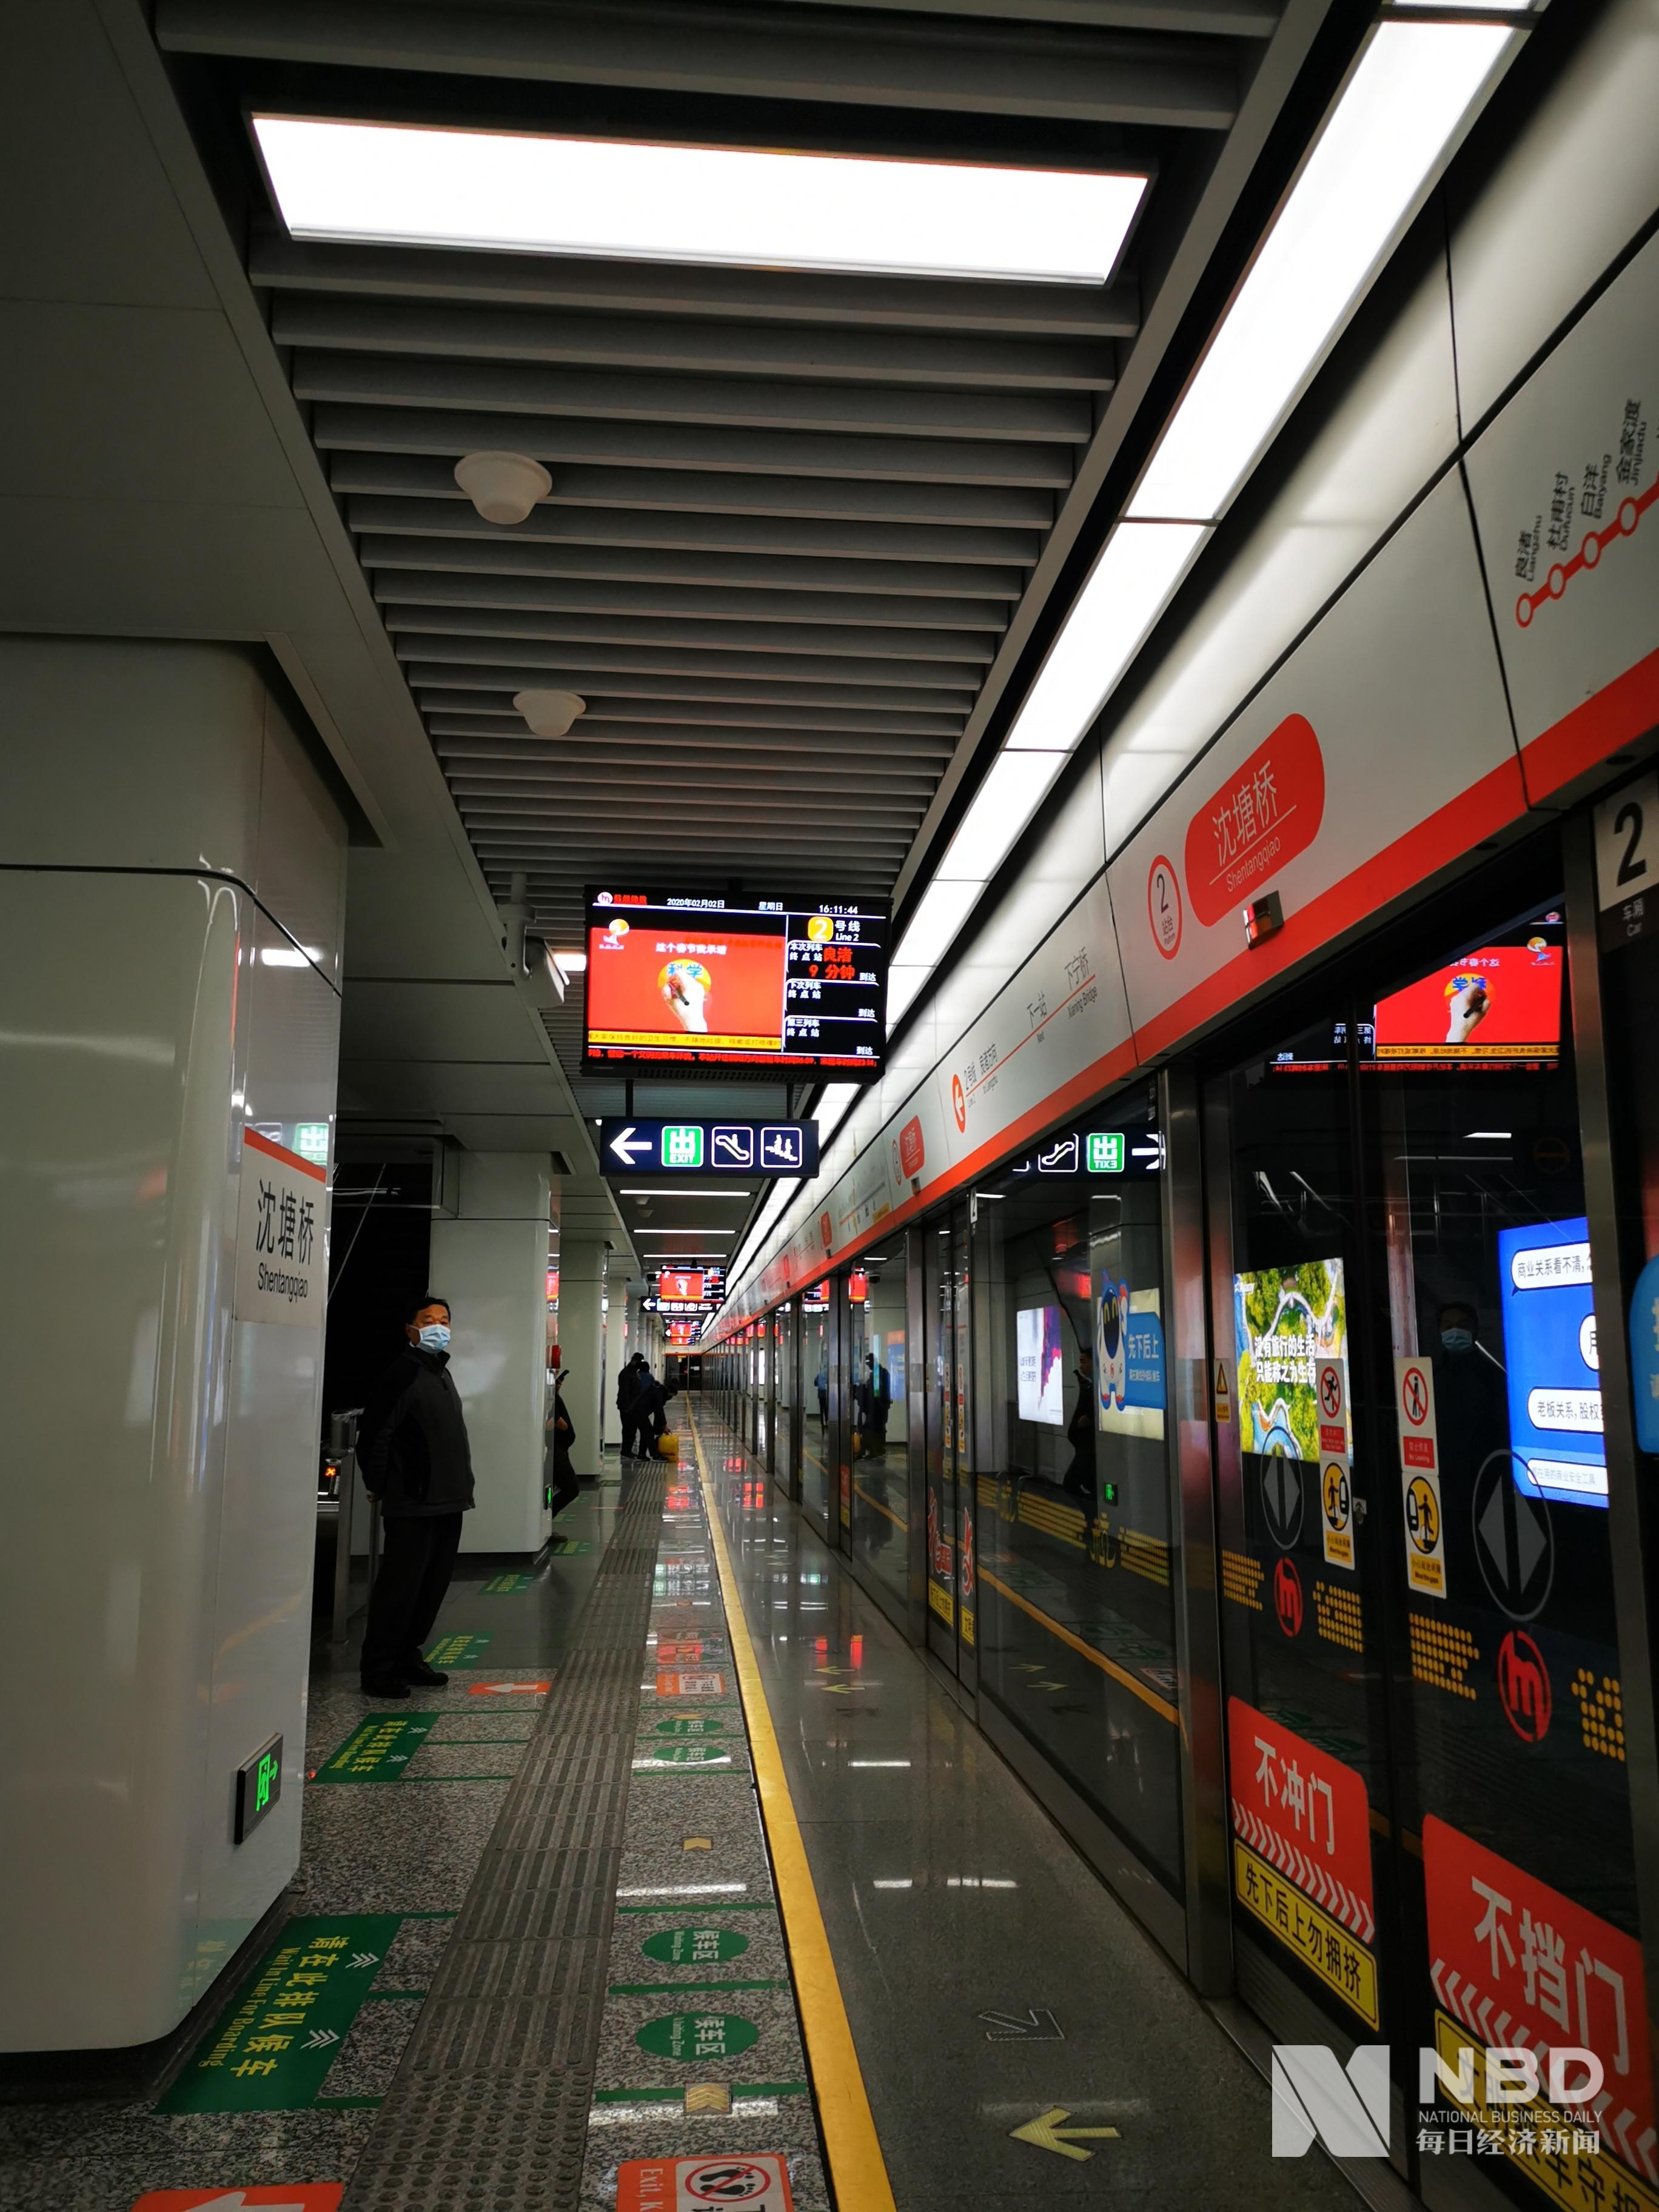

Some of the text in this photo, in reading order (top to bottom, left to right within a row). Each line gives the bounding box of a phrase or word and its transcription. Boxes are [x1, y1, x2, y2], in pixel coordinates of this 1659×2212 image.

[1616, 399, 1641, 484] 金家渡
[1581, 463, 1599, 516] 白洋
[1547, 472, 1569, 551] 杜甫村
[1515, 530, 1532, 578] 良渚
[1213, 760, 1278, 868] 沈塘桥
[1614, 802, 1647, 887] 2
[1227, 837, 1281, 893] Shentangqiao
[667, 899, 725, 908] 2020年02月02日
[759, 902, 783, 911] 星期日
[1157, 874, 1169, 914] 2
[819, 905, 858, 914] 16:11:44
[814, 919, 860, 939] 2 号线
[789, 943, 823, 952] 本次列车
[823, 947, 853, 963] 良渚
[789, 981, 821, 990] 下次列车
[809, 965, 855, 980] 9 分钟
[859, 973, 876, 981] 到达
[858, 1008, 876, 1018] 到达
[1027, 990, 1048, 1030] 下一站
[856, 1047, 873, 1055] 到达
[669, 1153, 695, 1164] EXIT
[256, 1179, 314, 1266] 沈塘桥
[258, 1262, 308, 1303] Shentangqiao
[1128, 1333, 1160, 1359] 先下后上
[1255, 1334, 1316, 1358] 没有旅行的生活
[1256, 1361, 1316, 1383] 只能称之为生存
[1255, 1735, 1335, 1855] 不冲门
[693, 1929, 720, 1961] 候车区
[1246, 1863, 1361, 2000] 先下后上勿拥挤
[272, 1947, 301, 1966] Wait
[266, 1967, 287, 1977] In
[1472, 1875, 1631, 2075] 不挡门
[251, 1978, 281, 1997] Line
[230, 1936, 350, 2077] 请在此排队候车
[239, 2000, 266, 2016] For
[198, 2017, 255, 2066] Boarding
[694, 2017, 726, 2055] 候车区
[636, 2168, 663, 2197] Exit,
